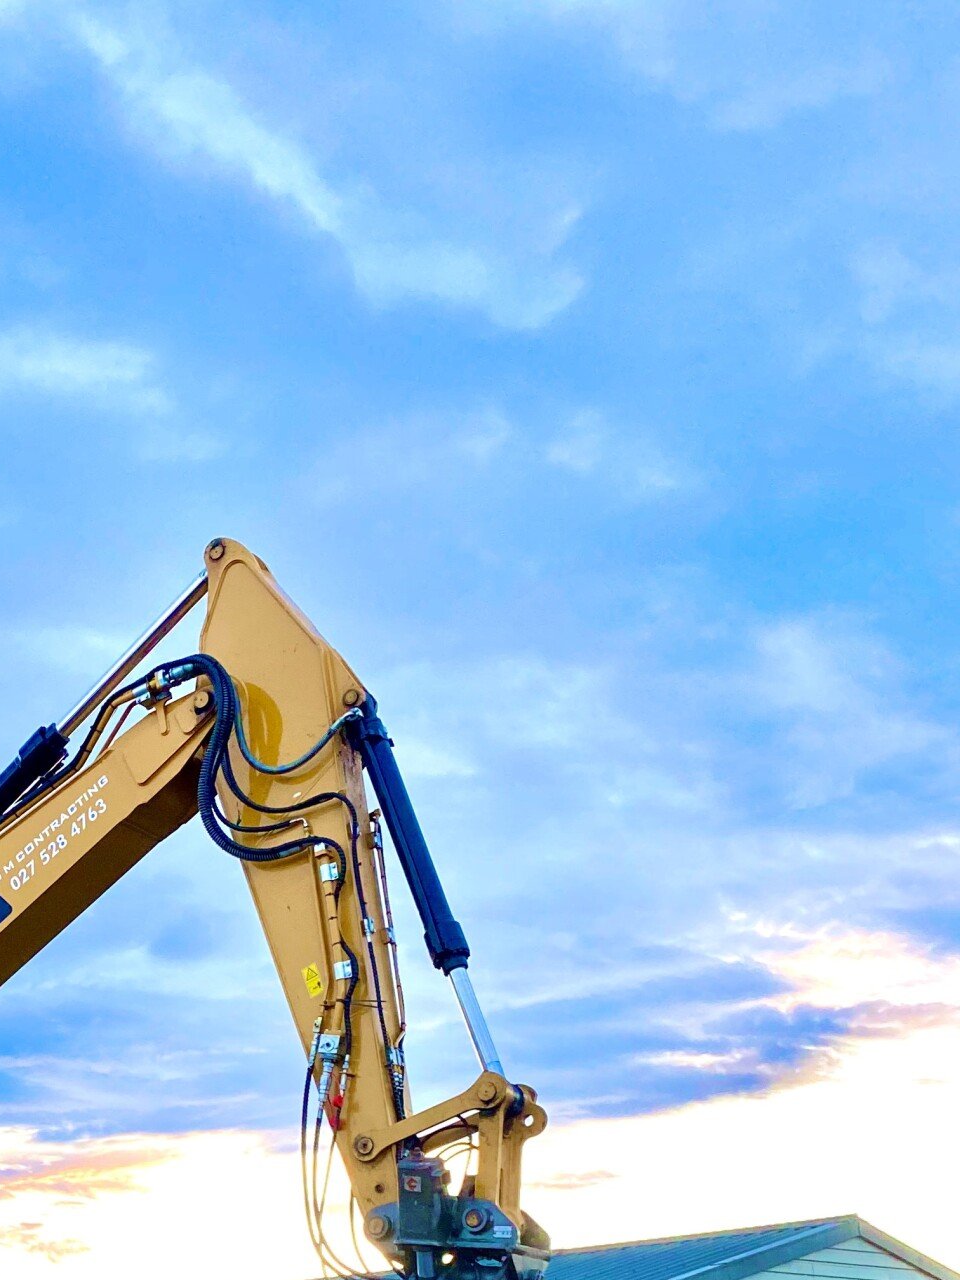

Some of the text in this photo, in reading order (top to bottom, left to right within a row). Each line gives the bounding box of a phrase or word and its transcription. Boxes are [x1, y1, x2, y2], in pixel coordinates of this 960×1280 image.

[3, 861, 15, 875] M
[16, 775, 109, 863] CONTRACTING
[9, 798, 108, 891] 027 528 4763
